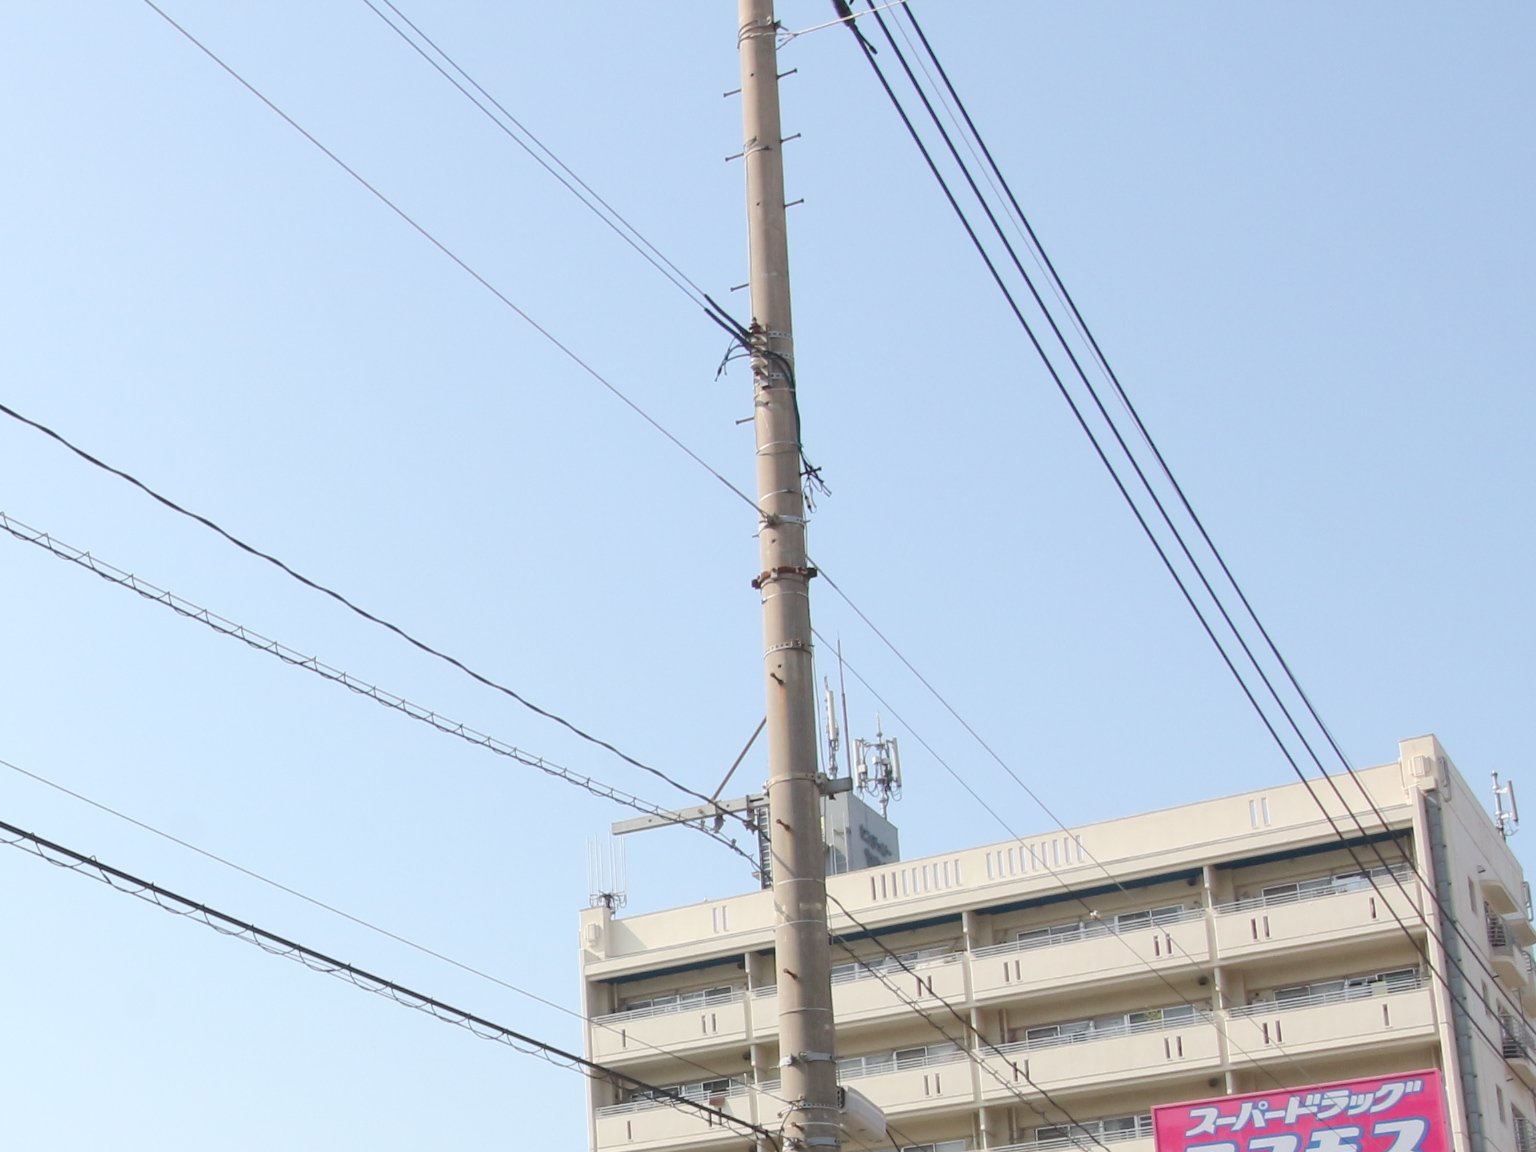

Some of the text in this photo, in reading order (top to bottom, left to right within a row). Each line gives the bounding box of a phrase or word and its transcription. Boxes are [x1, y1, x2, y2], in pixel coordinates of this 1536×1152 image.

[1185, 1079, 1424, 1137] スーパードラッグ
